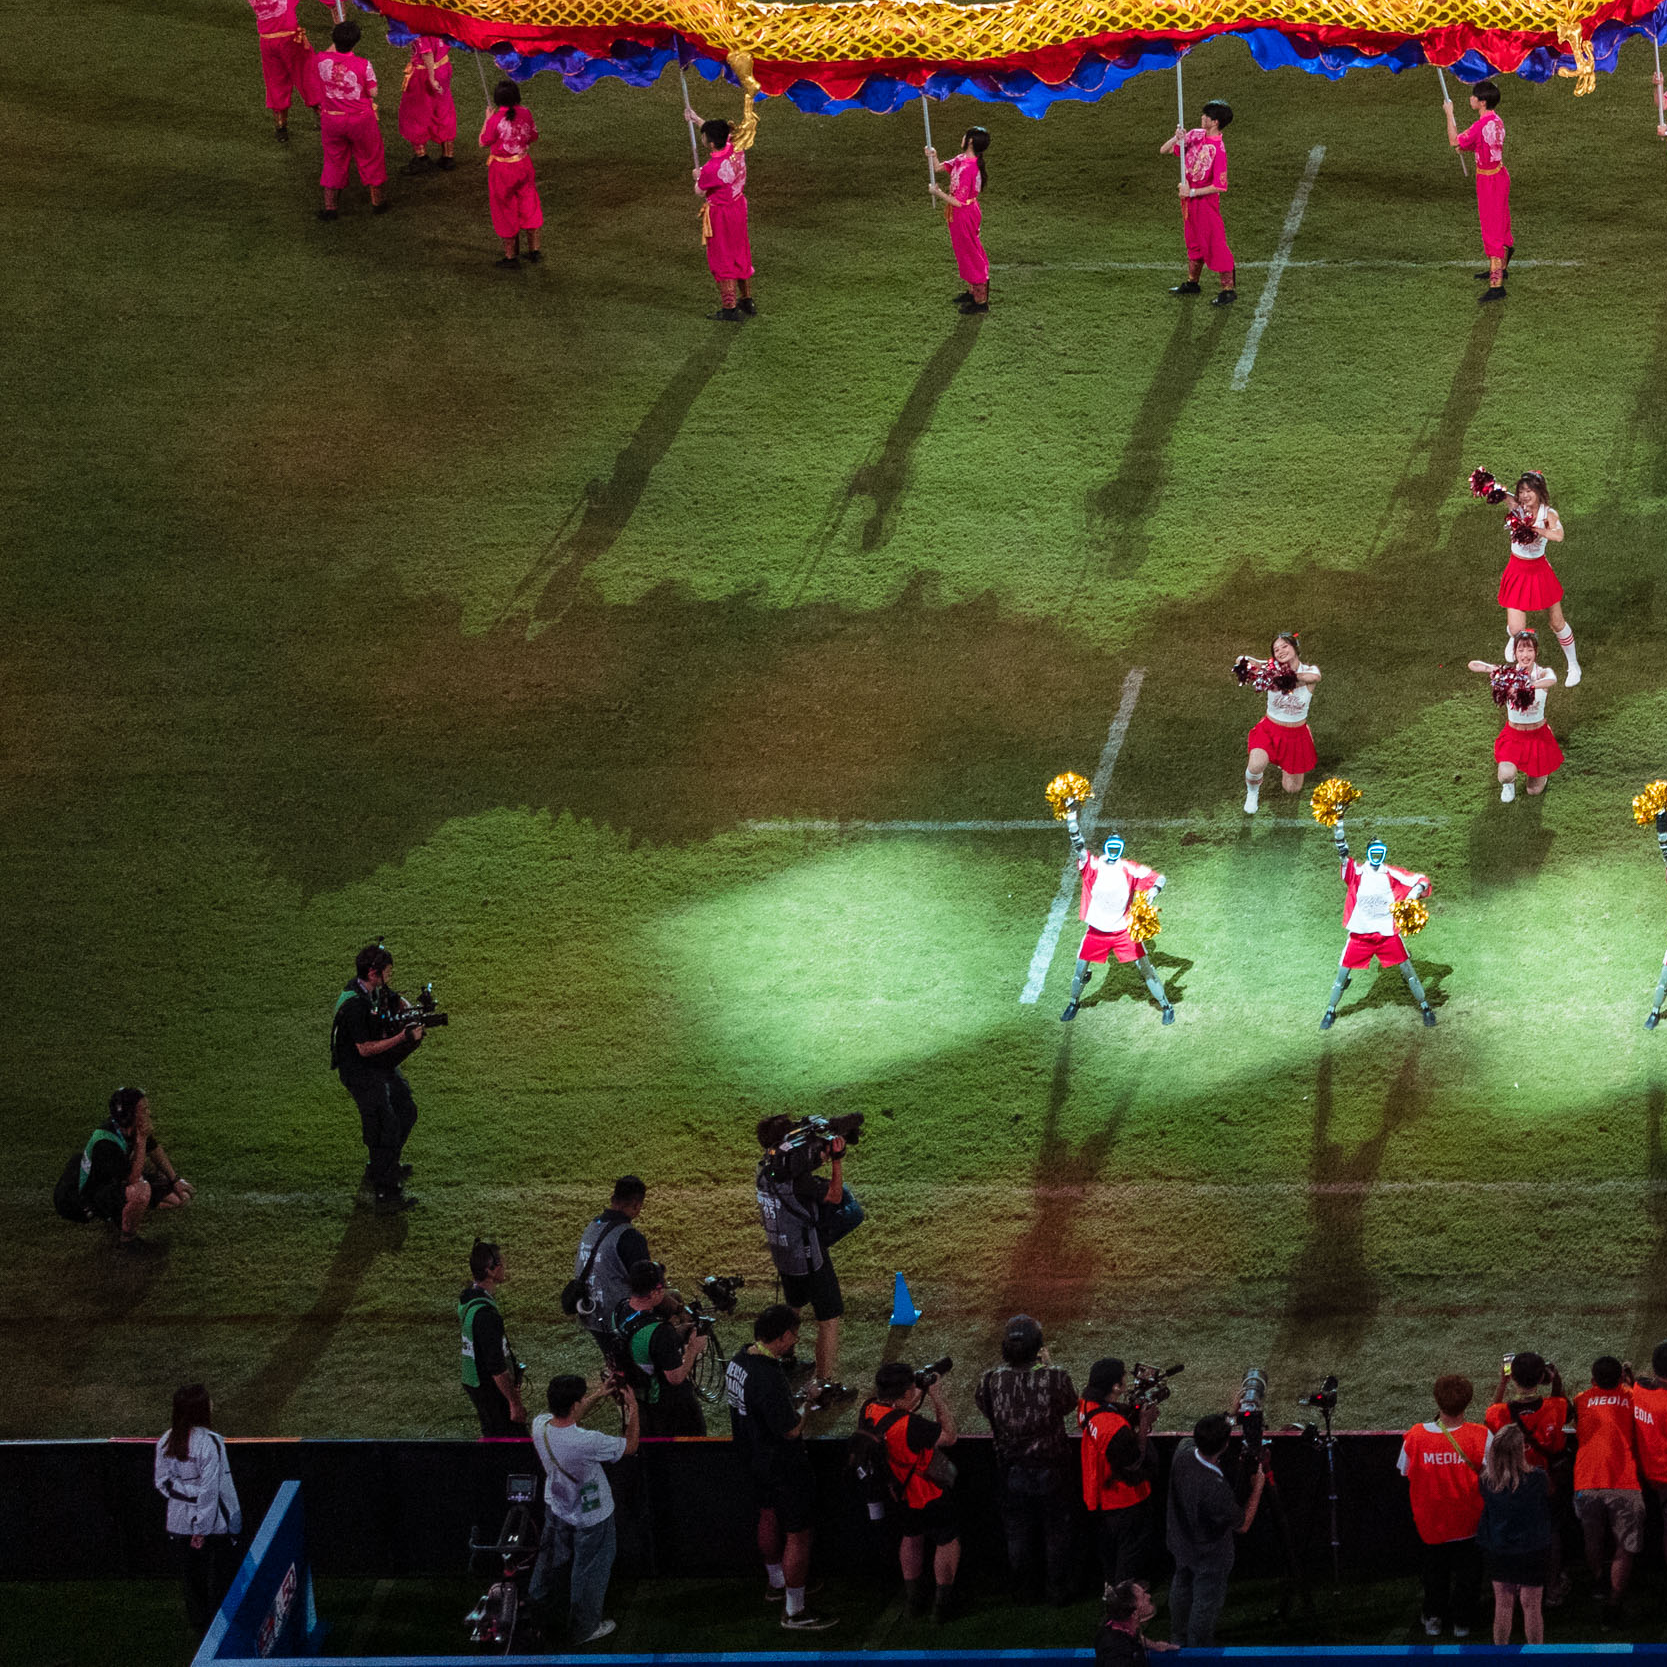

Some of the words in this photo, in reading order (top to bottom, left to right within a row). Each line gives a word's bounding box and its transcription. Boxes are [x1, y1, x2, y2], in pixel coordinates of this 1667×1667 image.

[1587, 1395, 1630, 1409] MEDIA
[1633, 1405, 1655, 1425] EDIA
[1423, 1451, 1466, 1465] MEDIA
